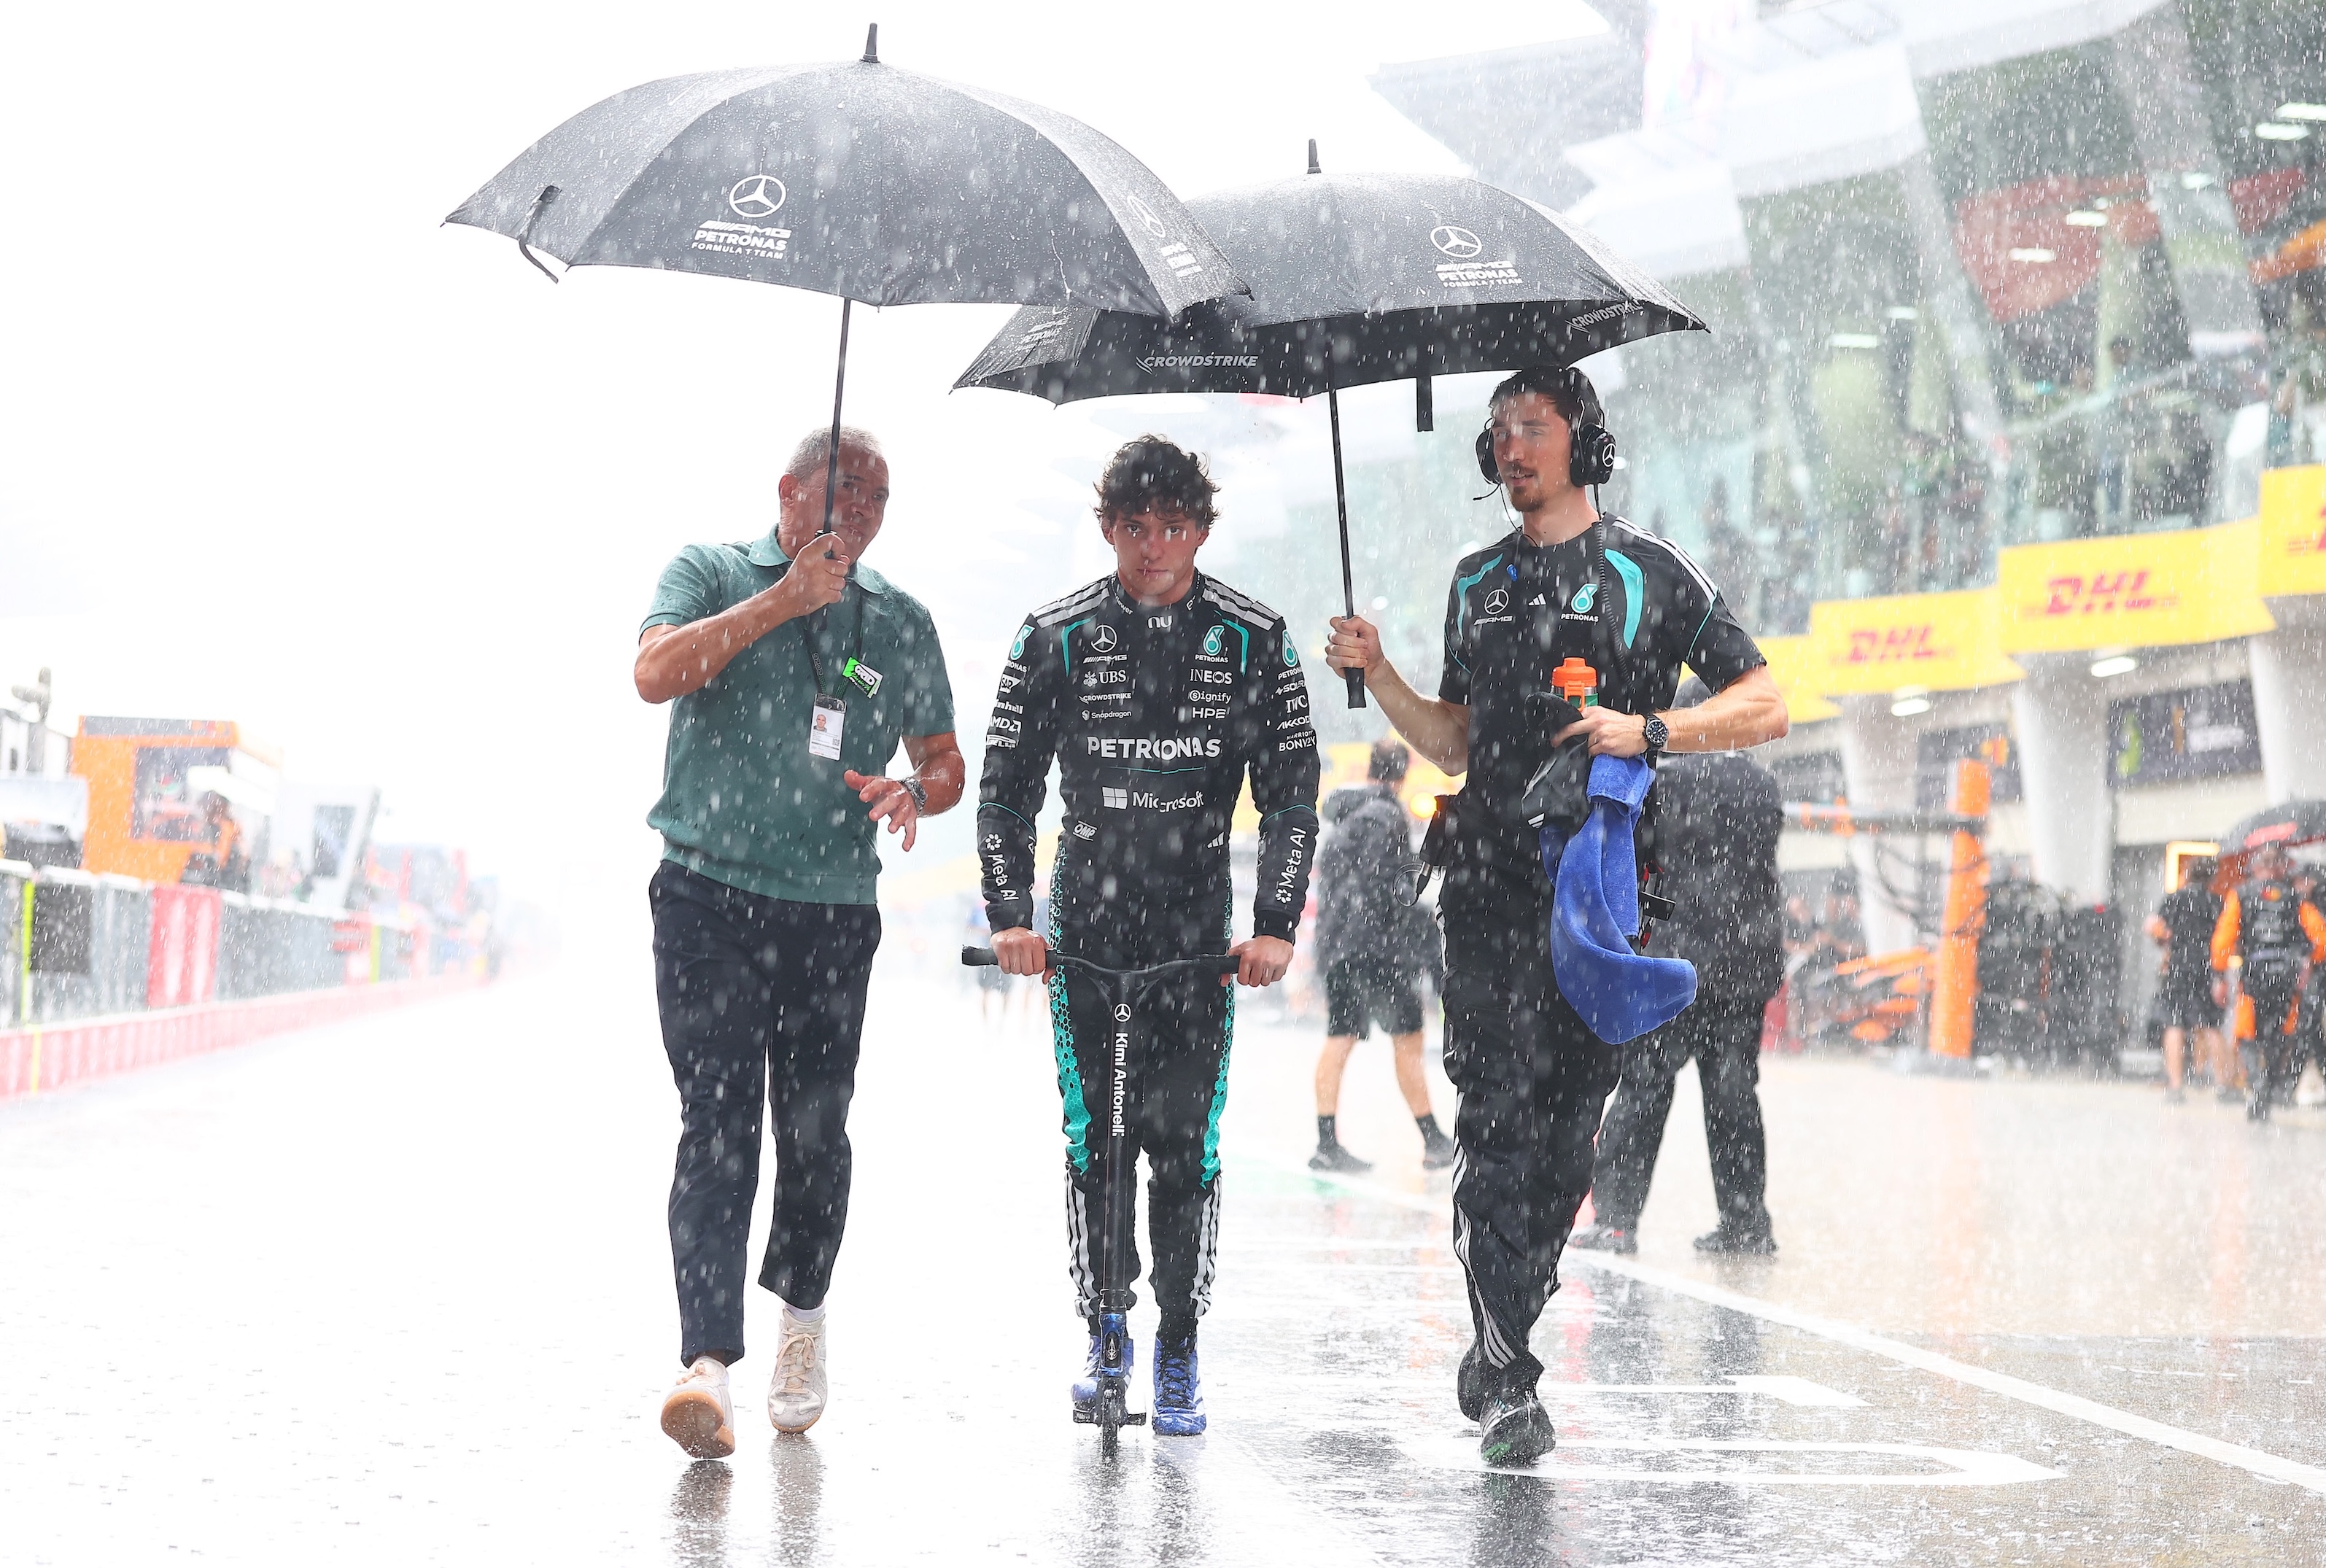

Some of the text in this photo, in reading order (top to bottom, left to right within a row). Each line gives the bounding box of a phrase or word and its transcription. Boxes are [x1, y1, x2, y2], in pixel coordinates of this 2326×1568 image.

[725, 222, 792, 238] AMG
[694, 230, 787, 251] PETRONAS
[691, 241, 743, 255] FORMULA
[754, 249, 784, 260] TEAM
[1455, 260, 1513, 271] AMG
[1437, 268, 1518, 282] PETRONAS
[1443, 280, 1489, 288] FORMULA
[1143, 355, 1259, 367] CROWDSTRIKE
[2045, 571, 2155, 614] DHL
[1147, 615, 1172, 628] nu
[1485, 616, 1513, 624] AMG
[1561, 613, 1599, 622] PETRONAS
[1849, 624, 1934, 662] DHL
[1094, 654, 1128, 662] AMG
[1195, 654, 1229, 663] PETRONAS
[1098, 669, 1127, 683] UBS
[1190, 669, 1233, 684] INEOS
[1278, 666, 1303, 680] PETRON
[1283, 679, 1306, 693] SOLER
[1083, 693, 1132, 701] CROWDSTRIKE
[1285, 694, 1308, 713] IWC
[1091, 711, 1132, 719] Snapdragon
[1192, 707, 1227, 718] HPE
[1087, 736, 1222, 760] PETRONAS
[1133, 790, 1204, 812] Microsoft
[1074, 823, 1096, 838] OMP
[1279, 827, 1306, 888] Meta AI
[988, 854, 1019, 900] Meta AI
[1115, 1033, 1128, 1066] Kimi
